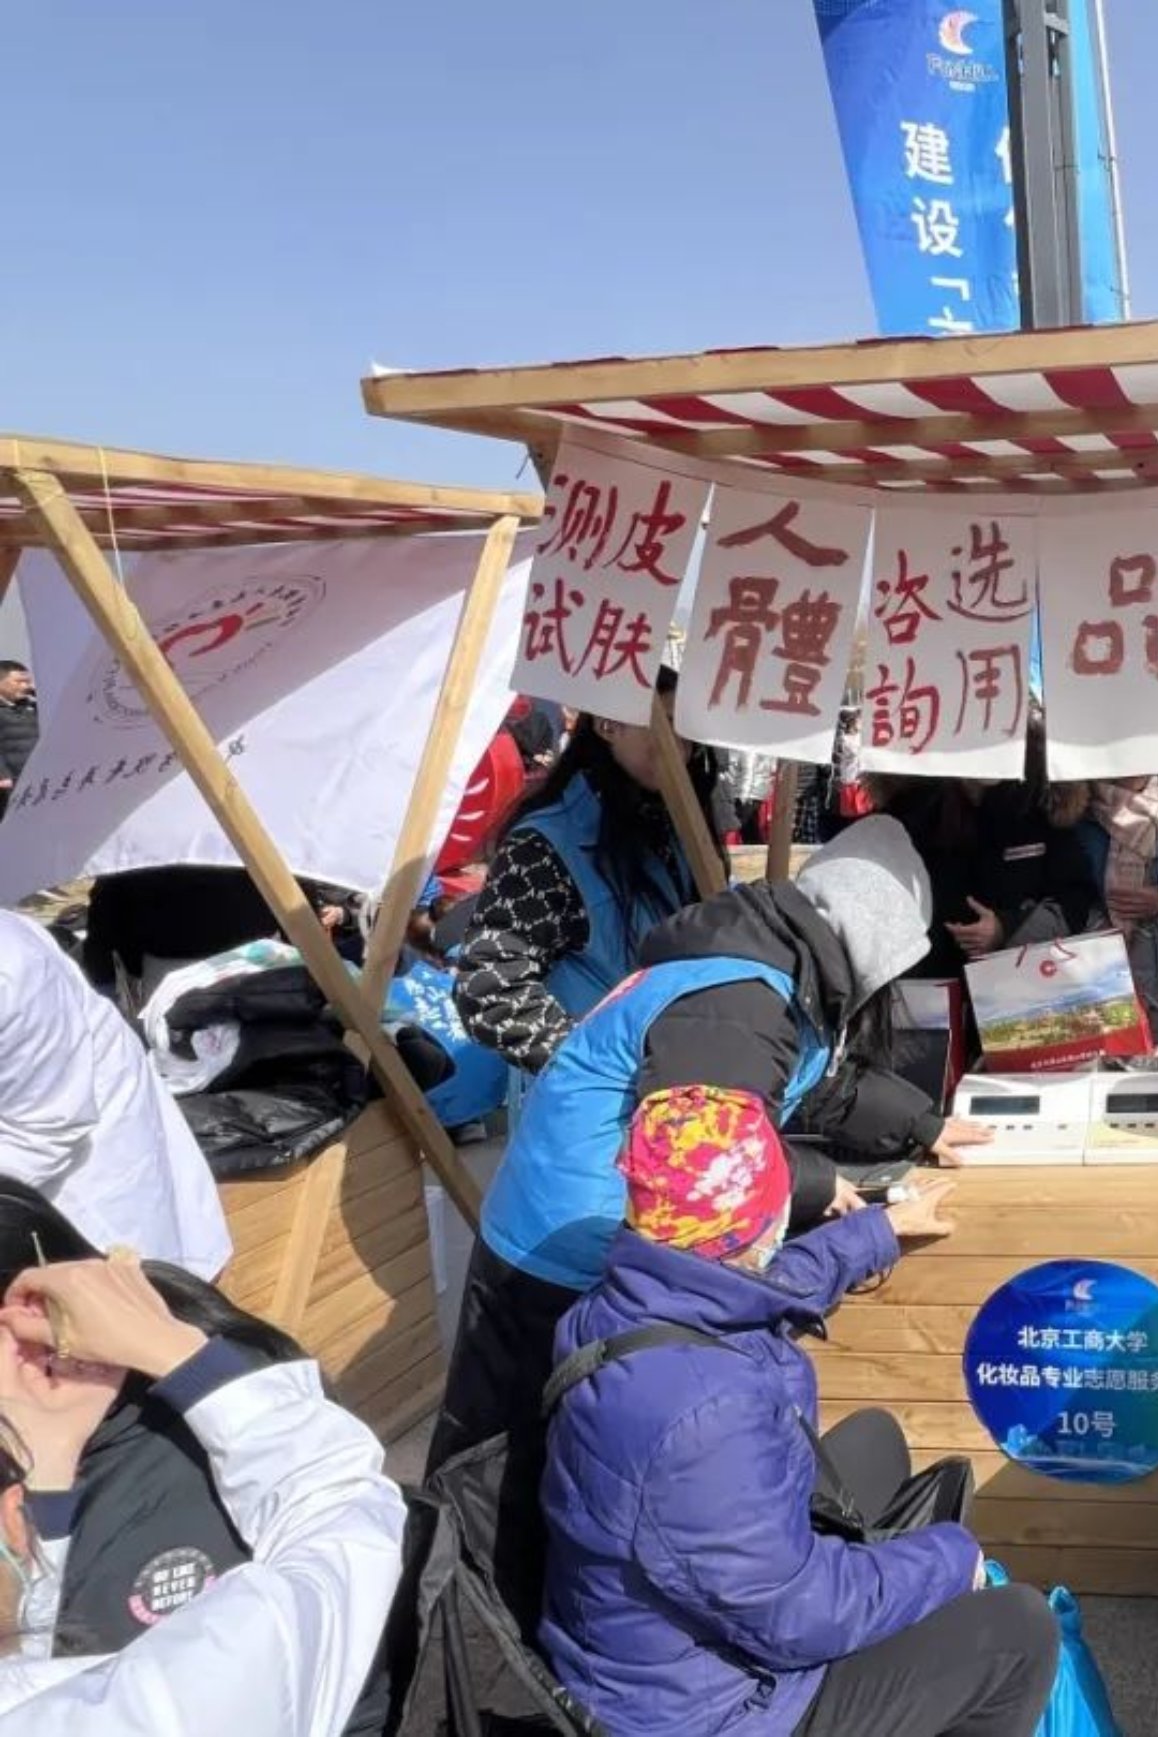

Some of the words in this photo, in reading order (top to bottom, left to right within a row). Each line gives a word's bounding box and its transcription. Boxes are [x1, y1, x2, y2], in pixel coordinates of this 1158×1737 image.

[1017, 1325, 1149, 1353] 北京工商大学
[1057, 1411, 1117, 1438] 10号
